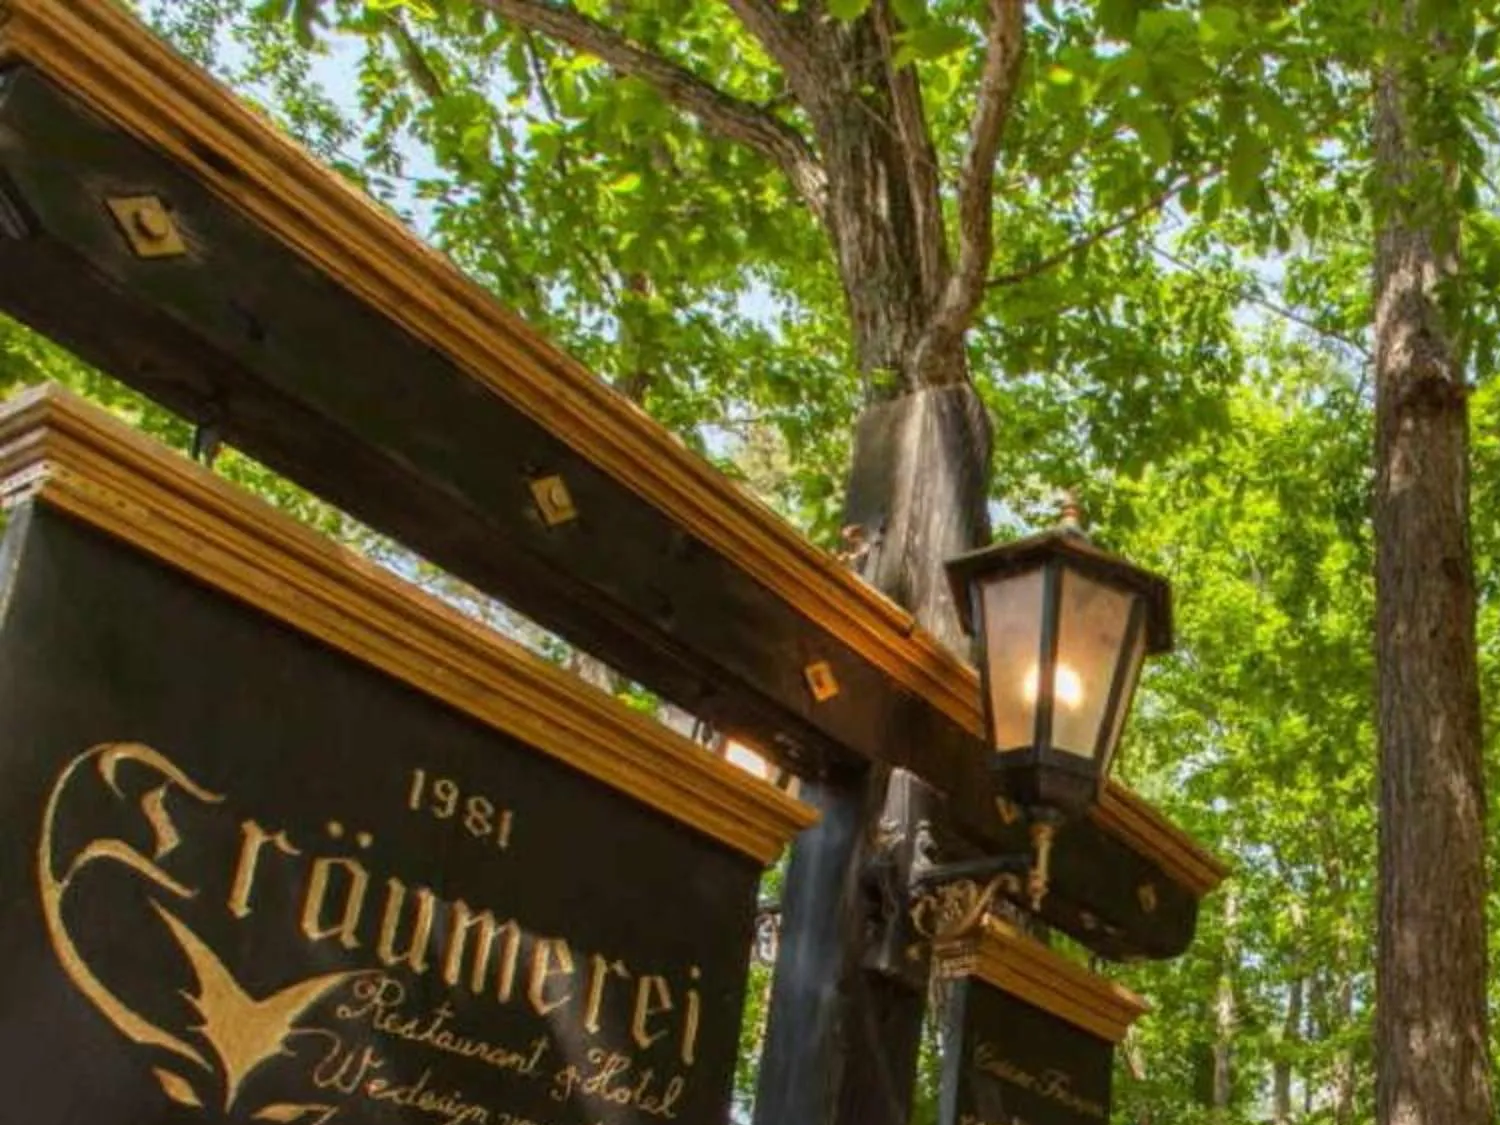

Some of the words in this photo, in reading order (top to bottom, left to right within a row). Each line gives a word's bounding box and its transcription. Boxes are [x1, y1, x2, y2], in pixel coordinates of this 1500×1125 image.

[410, 767, 513, 849] 1981
[336, 977, 548, 1074] Restaurant
[585, 1045, 684, 1119] Hotel
